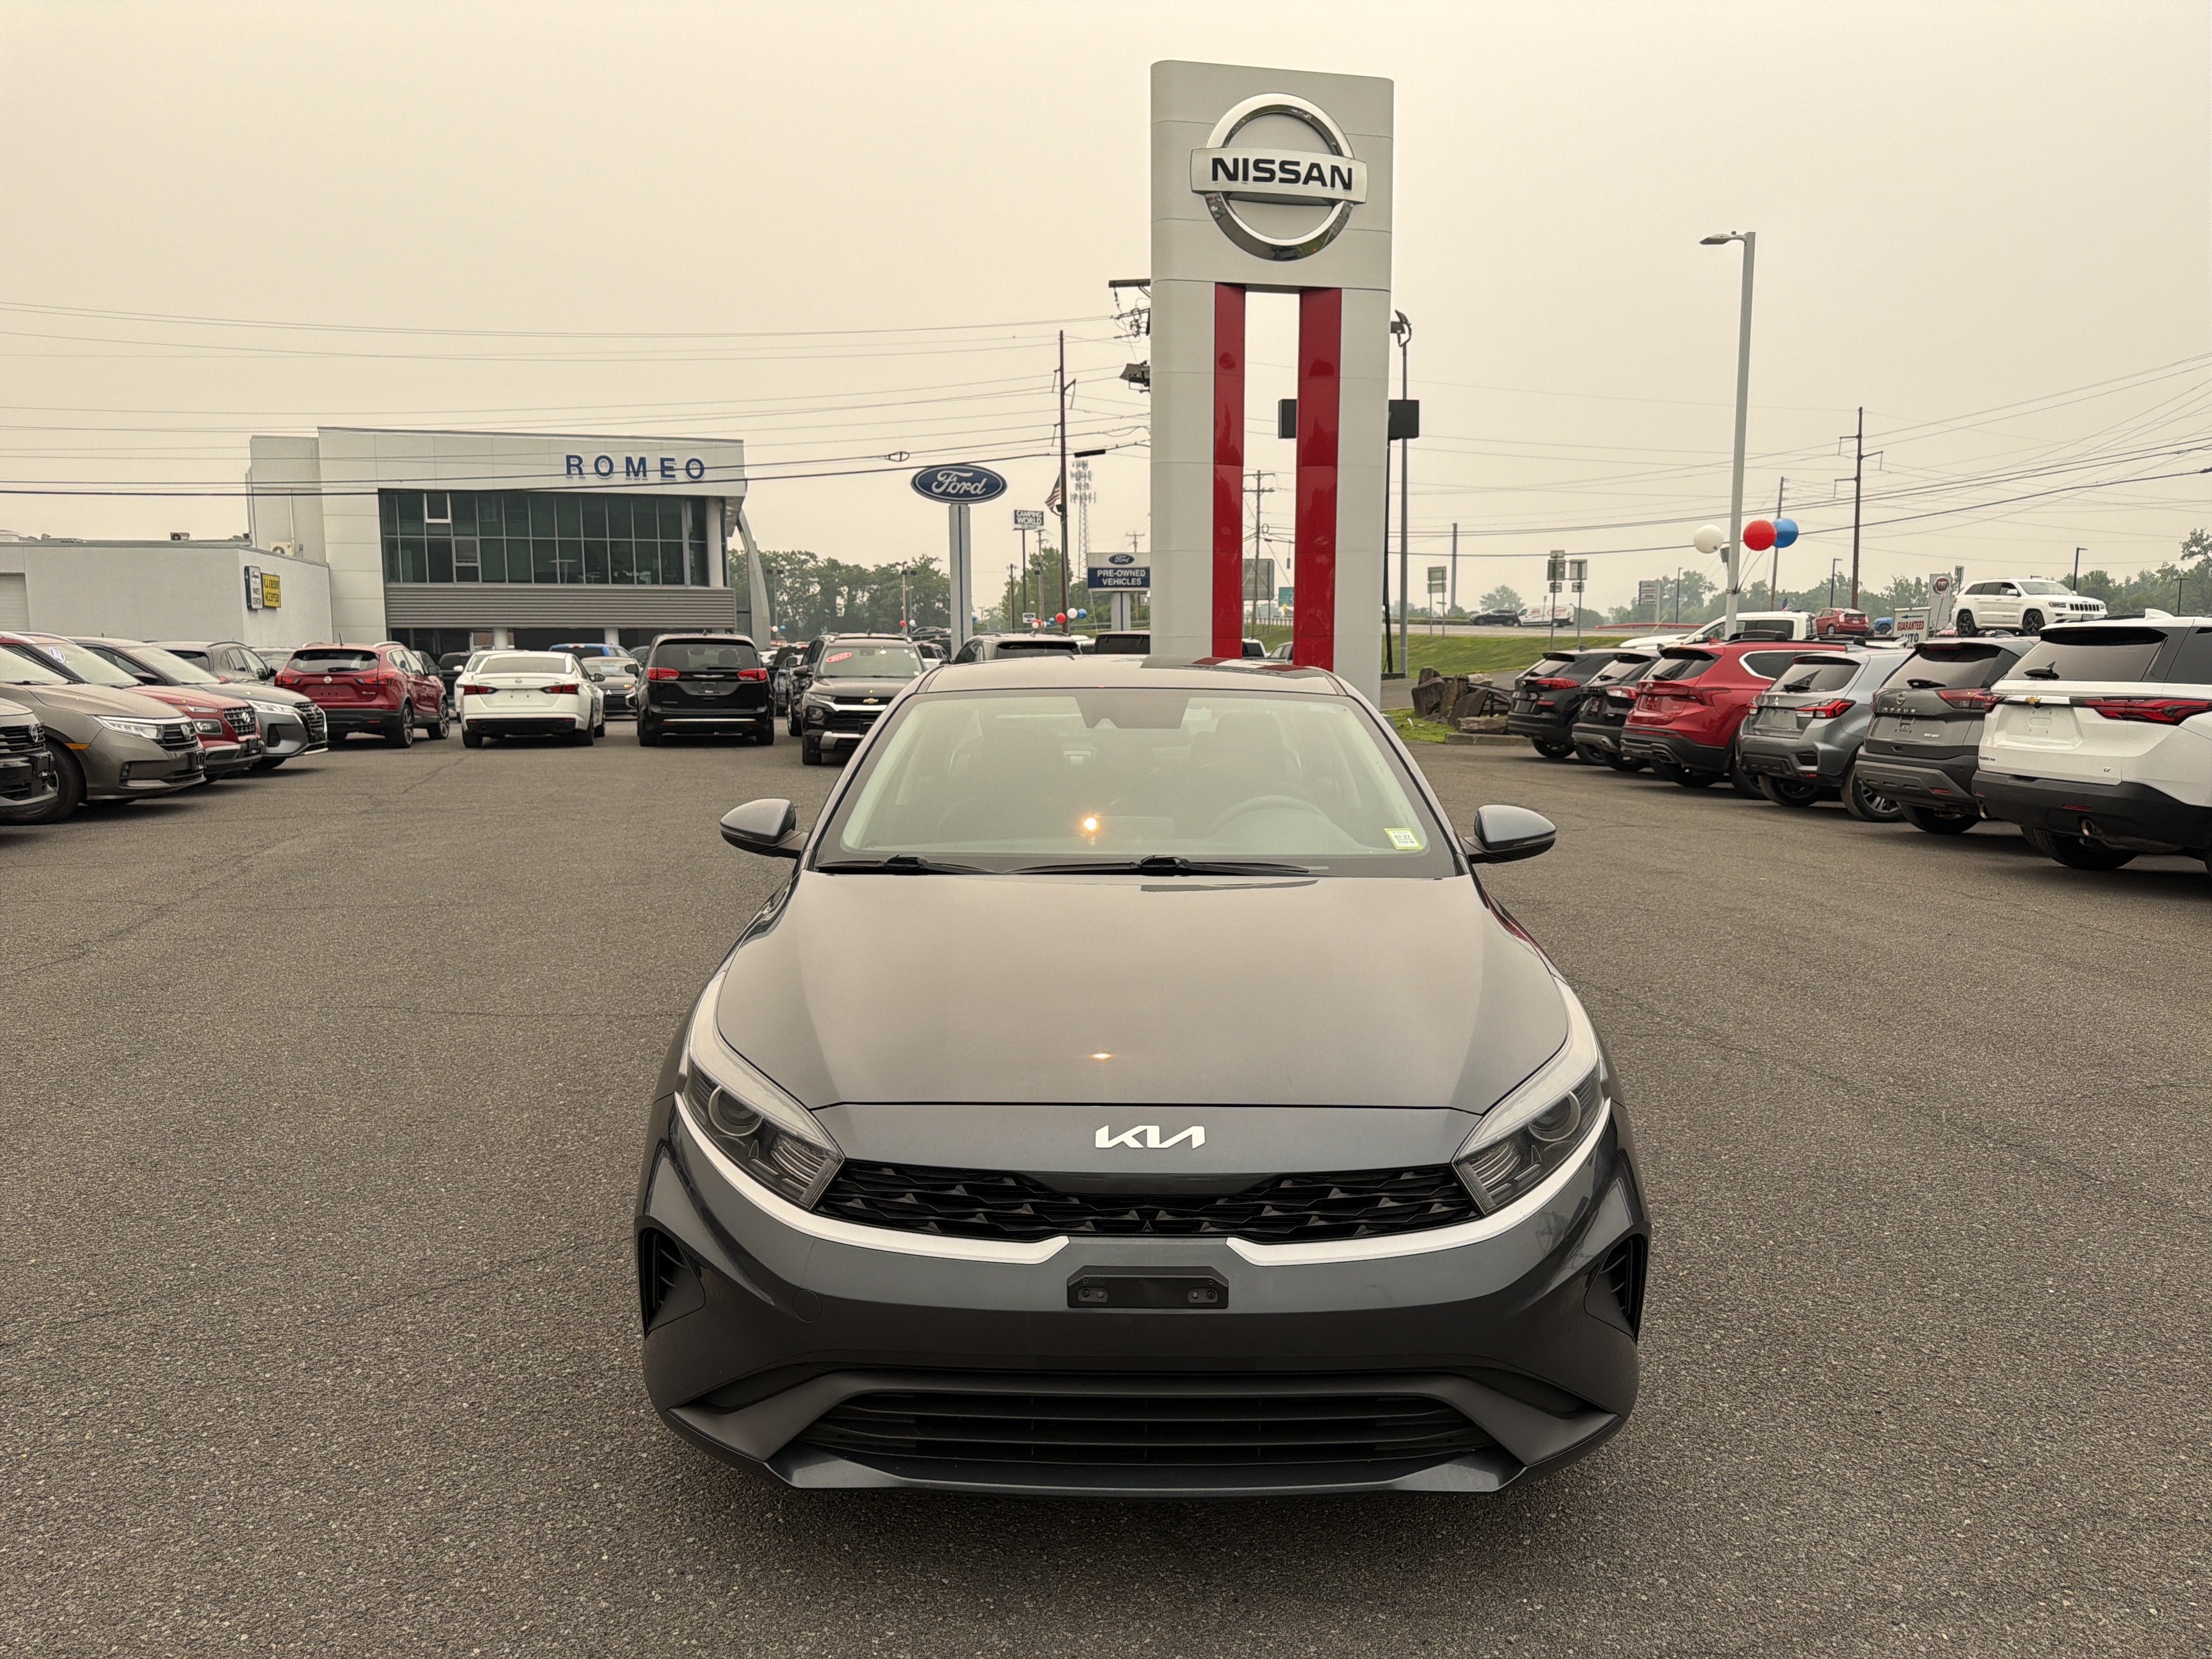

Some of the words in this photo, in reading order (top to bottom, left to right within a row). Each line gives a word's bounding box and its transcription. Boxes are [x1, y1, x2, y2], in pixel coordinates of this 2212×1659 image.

[1211, 157, 1352, 191] NISSAN
[566, 455, 706, 480] ROMEO
[932, 470, 988, 494] Ford
[1016, 517, 1042, 525] WORLD
[1097, 569, 1146, 577] PRE-OWNED
[1897, 620, 1924, 631] GUARANTEED
[1096, 1125, 1205, 1149] KIA
